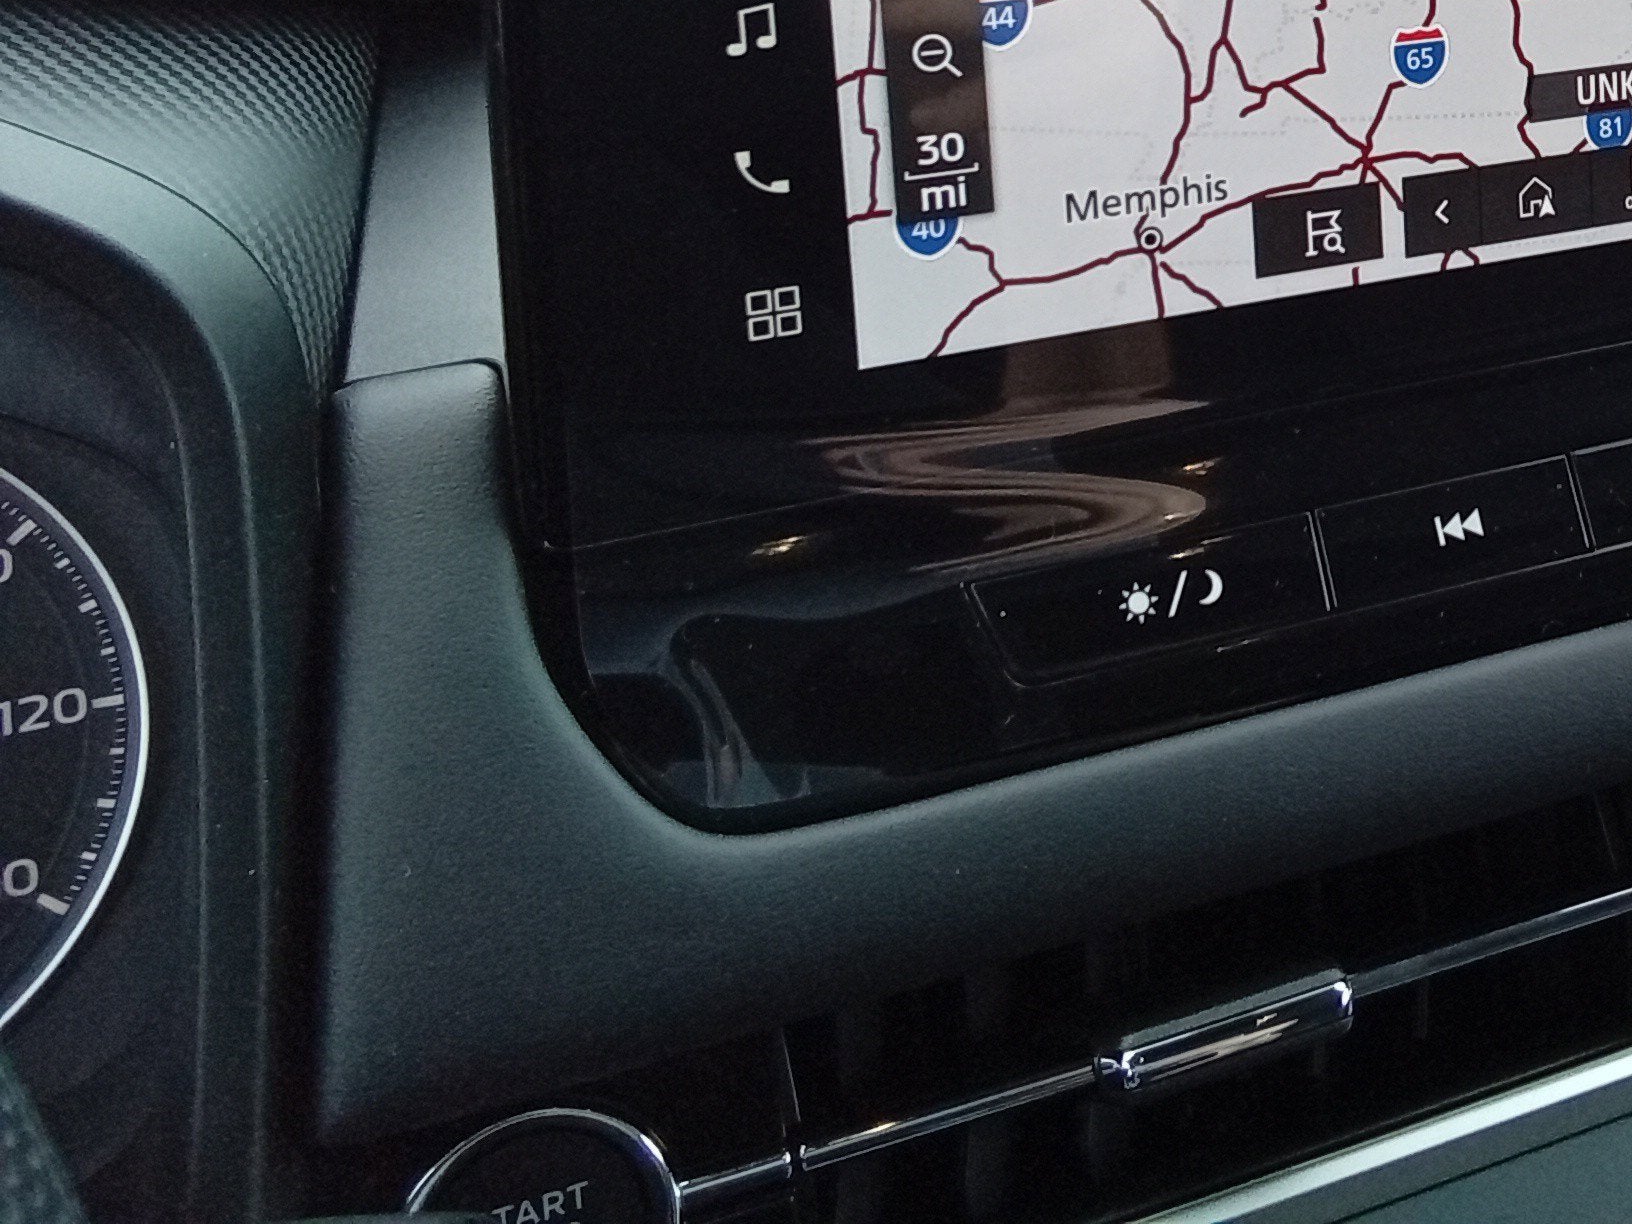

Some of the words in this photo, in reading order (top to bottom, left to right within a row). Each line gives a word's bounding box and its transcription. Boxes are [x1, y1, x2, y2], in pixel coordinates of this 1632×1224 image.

[982, 7, 1016, 30] 44
[1406, 47, 1433, 69] 65
[1599, 116, 1623, 137] 81
[916, 132, 965, 166] 30
[920, 177, 967, 213] mi
[1064, 176, 1228, 223] Memphis
[911, 224, 946, 240] 40
[0, 687, 88, 736] 120
[492, 1180, 589, 1224] TART
